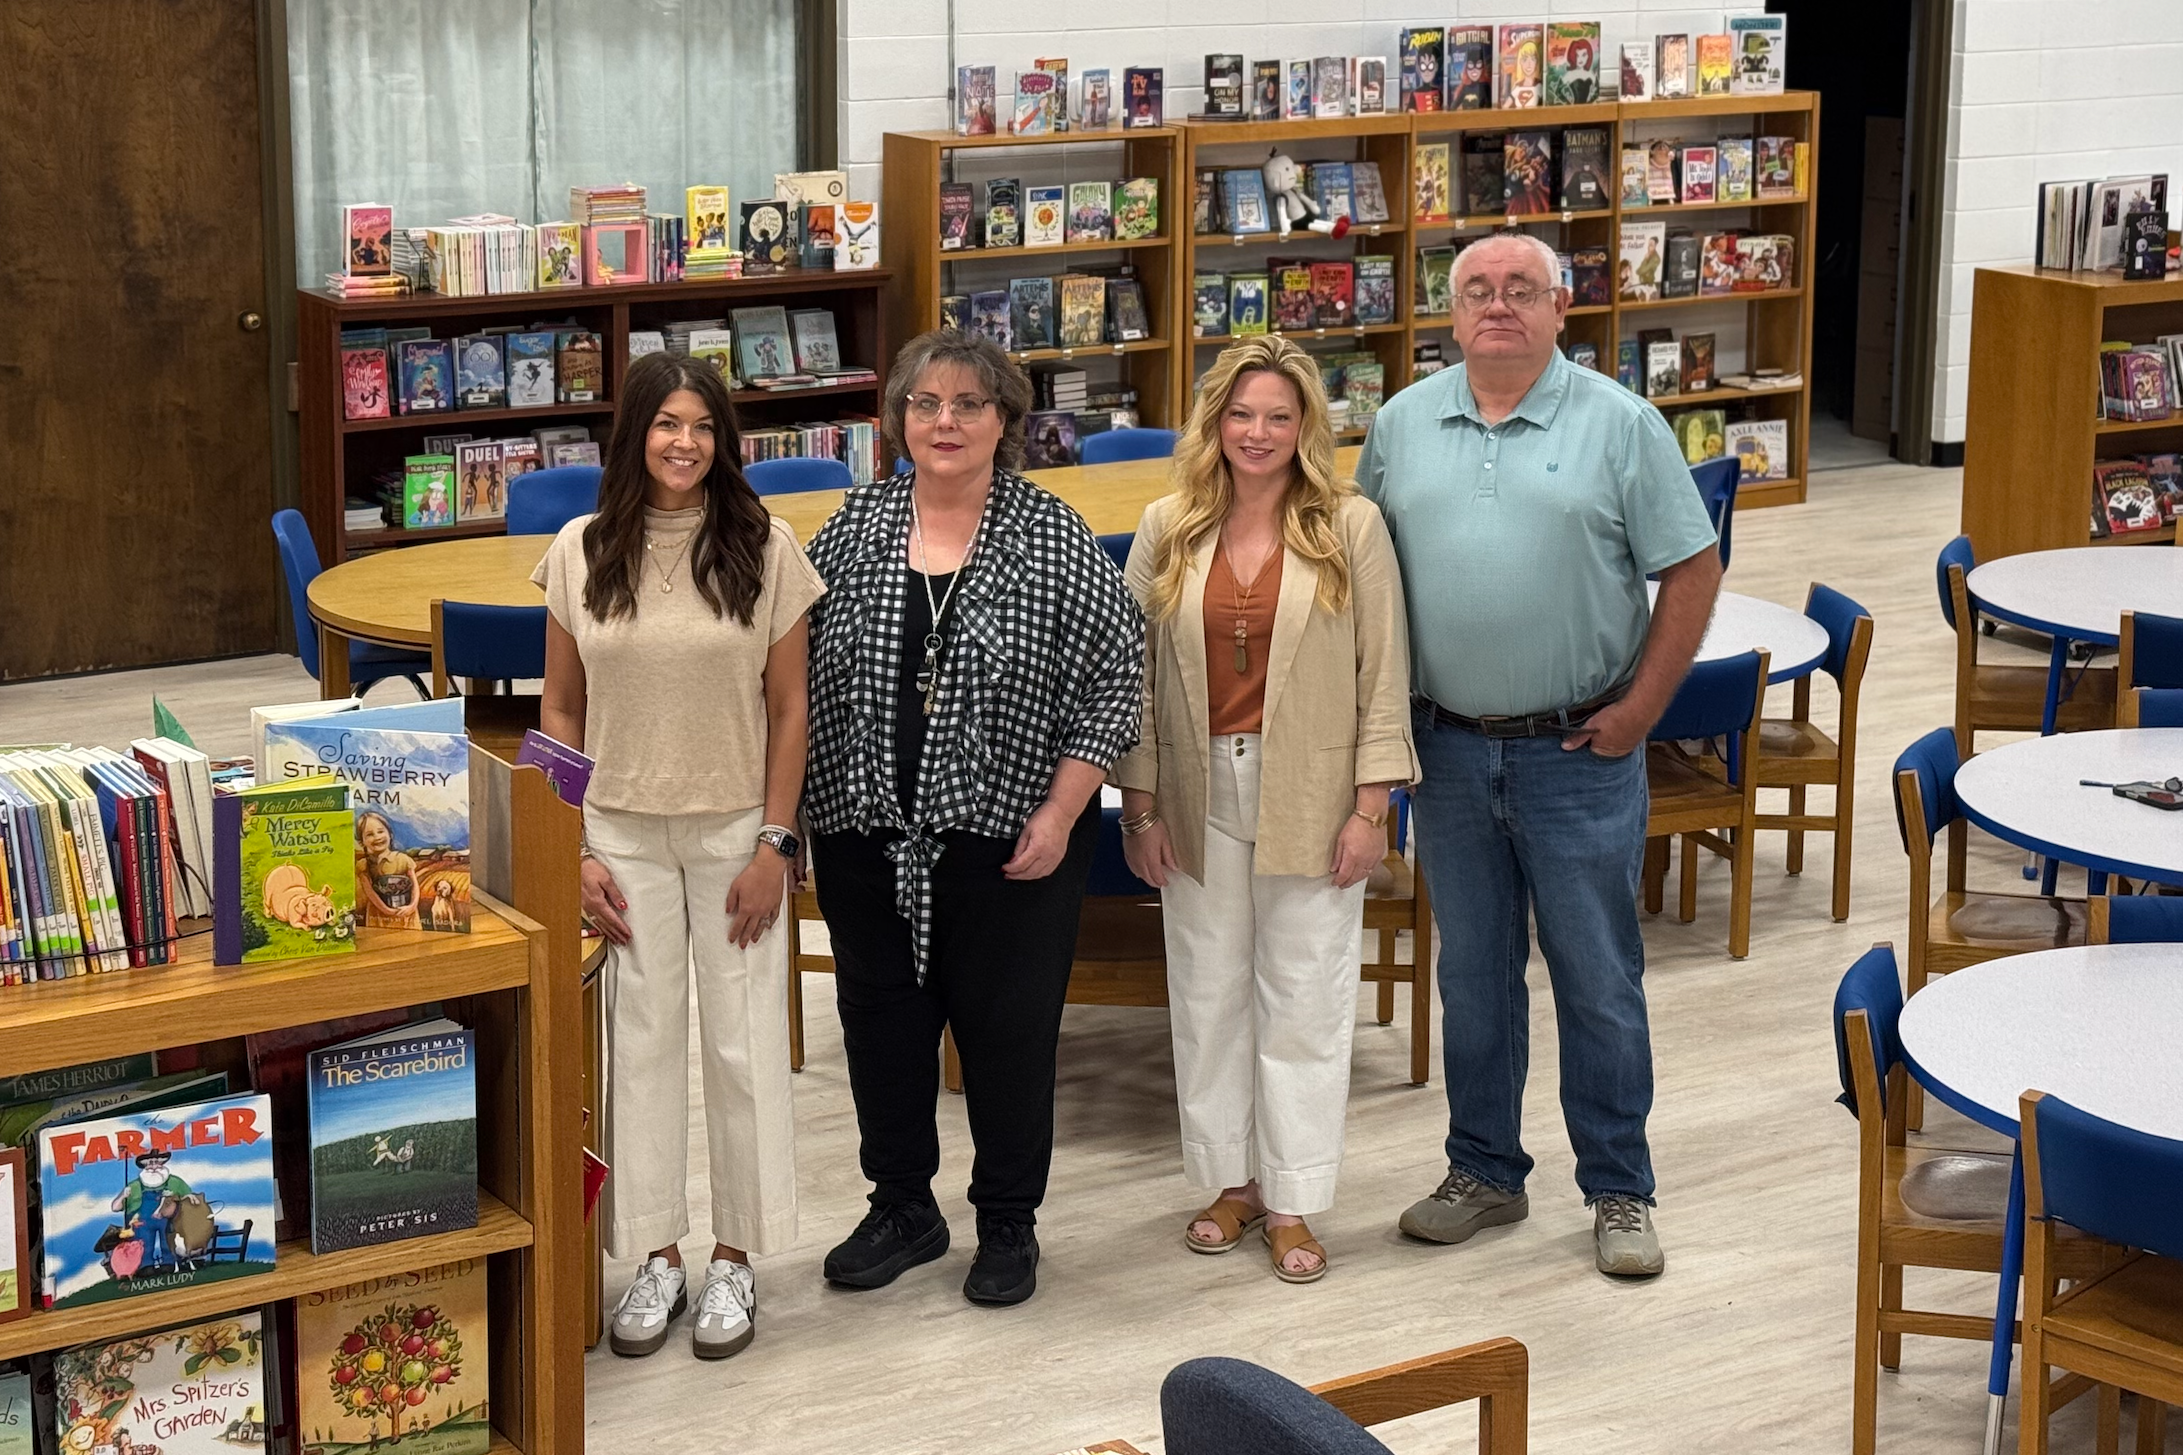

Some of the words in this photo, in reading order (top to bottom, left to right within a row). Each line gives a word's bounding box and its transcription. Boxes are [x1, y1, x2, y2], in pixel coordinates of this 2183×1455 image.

[1409, 31, 1442, 50] ROBIN
[1456, 30, 1490, 46] BATGIRL
[966, 86, 995, 98] NATE
[1131, 79, 1147, 88] TV
[1214, 88, 1226, 96] ON
[1227, 88, 1239, 96] MY
[1214, 96, 1240, 104] HONOR
[1073, 184, 1107, 203] GALAXY
[1369, 268, 1391, 276] EARTH
[1013, 281, 1049, 293] ARTEMIS
[1065, 282, 1104, 293] ARTEMIS
[1235, 281, 1263, 290] ALVIN
[1242, 289, 1256, 298] HO
[564, 368, 602, 381] HARPER
[1731, 425, 1752, 438] AXLE
[1757, 423, 1784, 434] ANNIE
[465, 446, 499, 463] DUEL
[318, 732, 406, 772] Saving
[284, 761, 452, 787] STRAWBERRY
[261, 800, 285, 814] Kate
[287, 796, 335, 813] DiCamillo
[265, 816, 322, 834] Mercy
[268, 832, 331, 848] Watson
[97, 856, 107, 871] PIG
[80, 853, 90, 880] SMALL
[86, 881, 95, 896] PIG
[323, 1055, 350, 1066] SID
[361, 1037, 465, 1060] FLEISCHMAN
[322, 1067, 363, 1088] The
[365, 1048, 466, 1082] Scarebird
[12, 1073, 61, 1098] JAMES
[63, 1061, 128, 1088] HERRIOT
[50, 1107, 264, 1176] FARMER
[360, 1219, 404, 1234] PETER
[414, 1212, 437, 1224] SIS
[130, 1277, 164, 1292] MARK
[166, 1271, 196, 1286] LUDY
[308, 1277, 380, 1307] SEED
[385, 1275, 398, 1290] by
[404, 1259, 474, 1288] SEED
[133, 1396, 170, 1425] Mrs.
